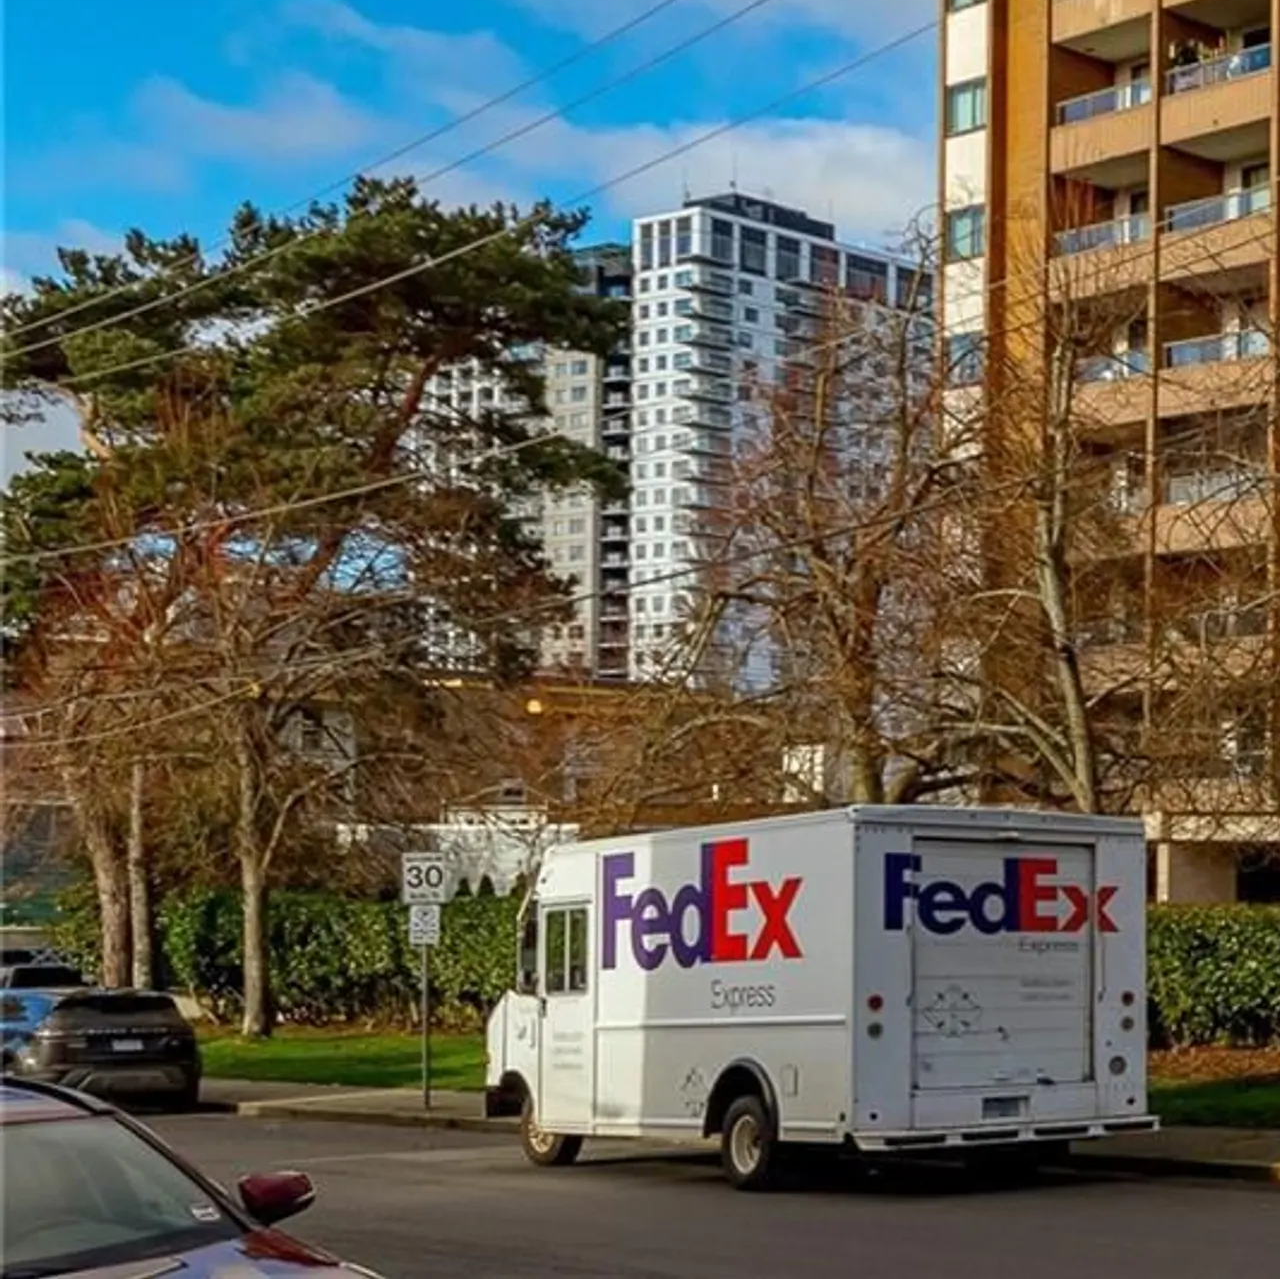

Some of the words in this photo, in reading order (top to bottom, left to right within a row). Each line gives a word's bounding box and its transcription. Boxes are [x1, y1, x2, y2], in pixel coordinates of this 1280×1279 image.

[407, 864, 443, 889] 30
[884, 852, 1119, 935] FedEx
[602, 838, 804, 971] FedEx
[1018, 940, 1079, 956] Express
[711, 979, 777, 1013] Express
